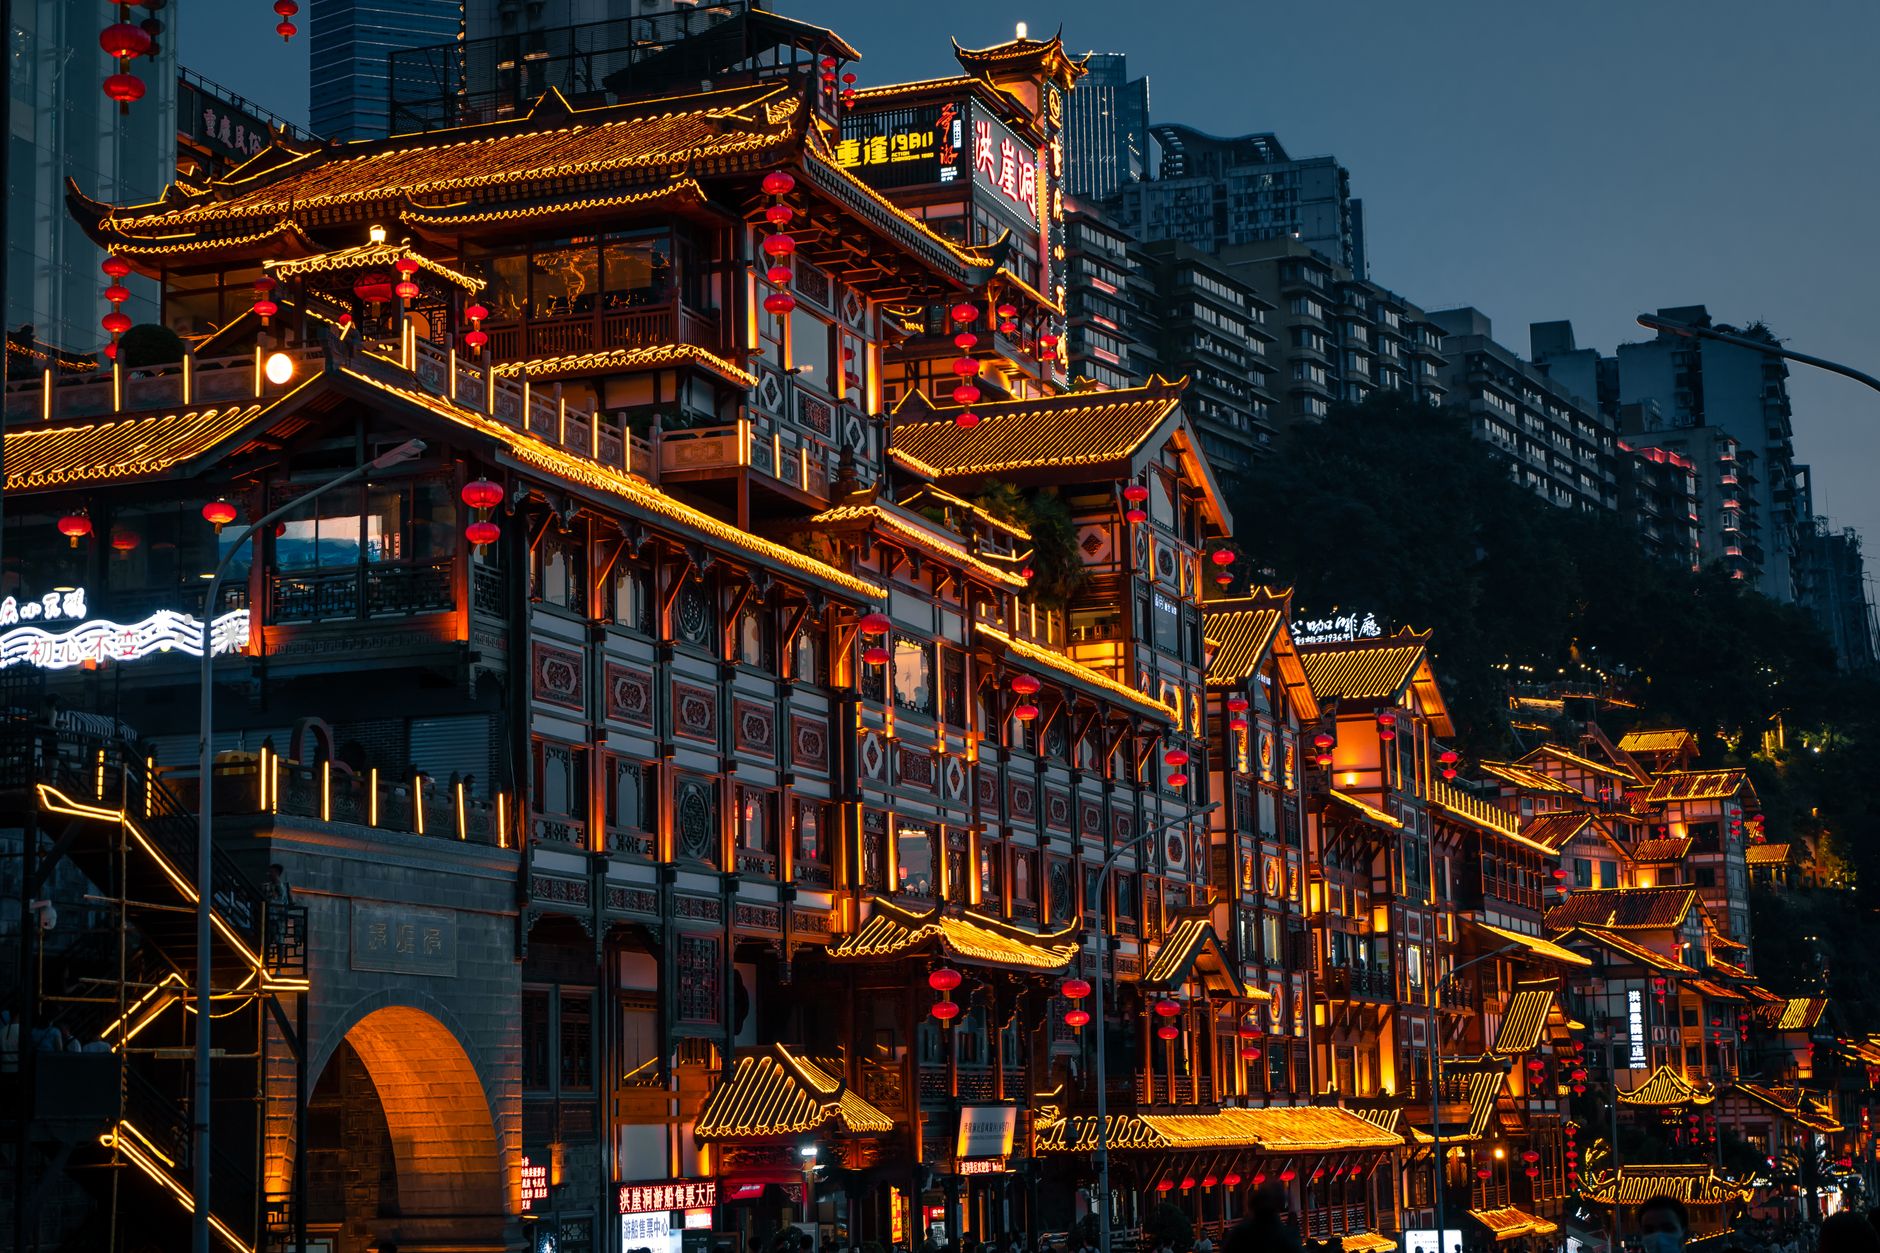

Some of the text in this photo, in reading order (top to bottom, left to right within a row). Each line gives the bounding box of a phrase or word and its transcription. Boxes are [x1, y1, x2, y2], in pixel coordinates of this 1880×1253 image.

[975, 120, 1036, 217] 洪崖洞
[29, 629, 140, 663] 初心不变
[619, 1183, 716, 1211] 洪崖洞游船售票大厅
[623, 1217, 669, 1241] 游船售票中心
